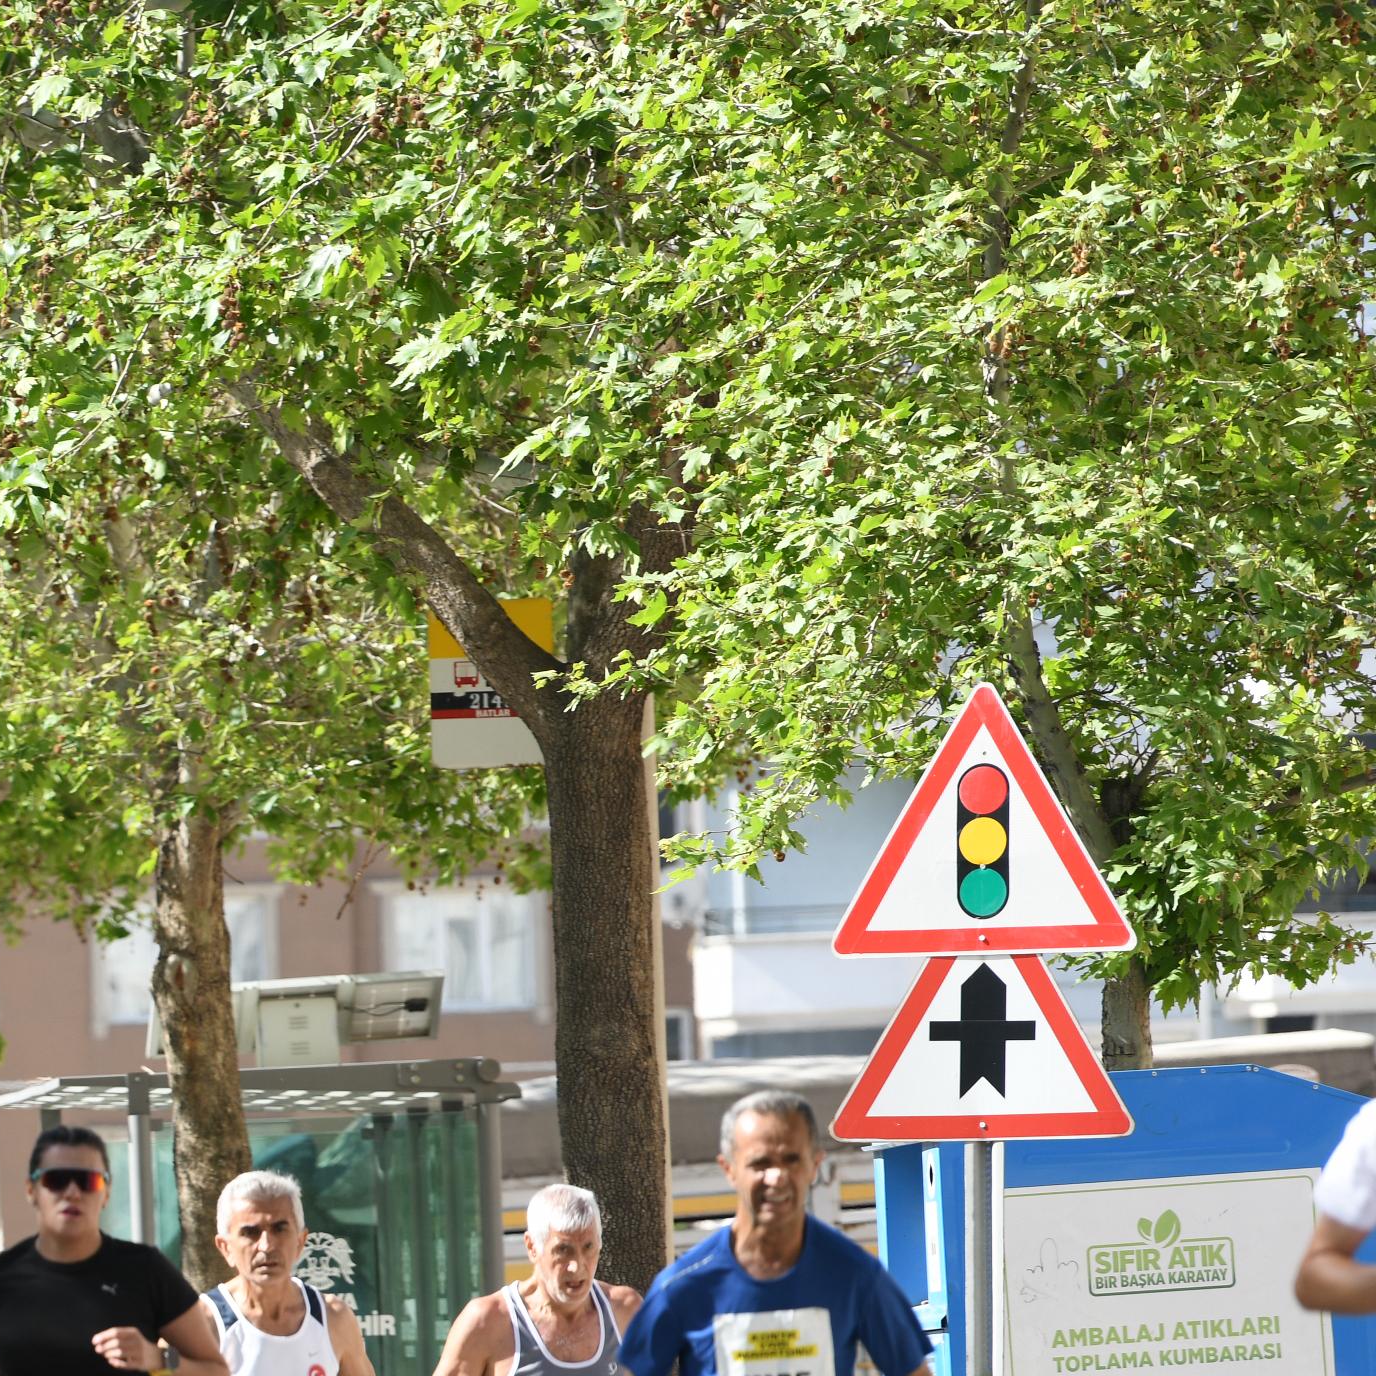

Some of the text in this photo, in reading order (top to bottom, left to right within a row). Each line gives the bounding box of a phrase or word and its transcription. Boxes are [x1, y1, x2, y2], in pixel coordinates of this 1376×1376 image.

[1094, 1242, 1228, 1275] SIFIR ATIK
[1120, 1271, 1166, 1289] BAŞKA
[1167, 1267, 1228, 1285] KARATAY
[1051, 1315, 1281, 1349] AMBALAJ ATIKLARI
[1052, 1342, 1282, 1373] TOPLAMA KUMBARASI
